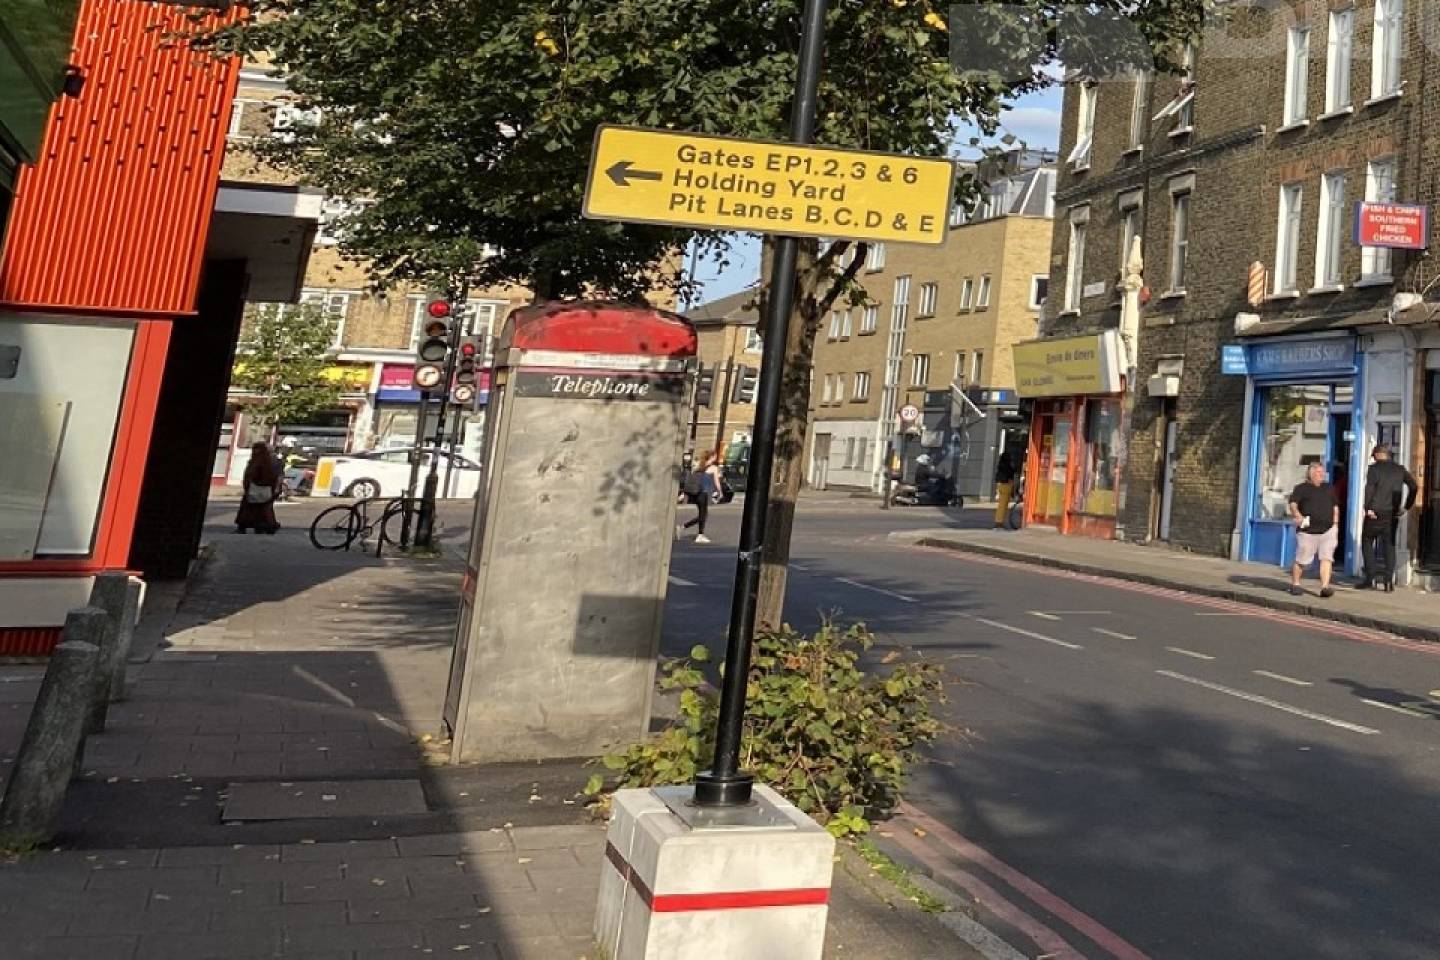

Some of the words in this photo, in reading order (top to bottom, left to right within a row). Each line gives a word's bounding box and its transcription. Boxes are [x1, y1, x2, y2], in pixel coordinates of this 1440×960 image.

[677, 145, 755, 169] Gates
[877, 165, 892, 182] &
[903, 167, 918, 184] 6
[673, 169, 776, 199] Holding
[789, 180, 846, 202] Yard
[669, 193, 705, 214] Pit
[717, 198, 793, 220] Lanes
[892, 214, 908, 231] &
[920, 215, 935, 232] E
[1369, 215, 1417, 225] SOUTHERN
[1373, 233, 1412, 243] CHICKEN
[1380, 224, 1407, 233] FRIED
[552, 374, 650, 397] Telephone
